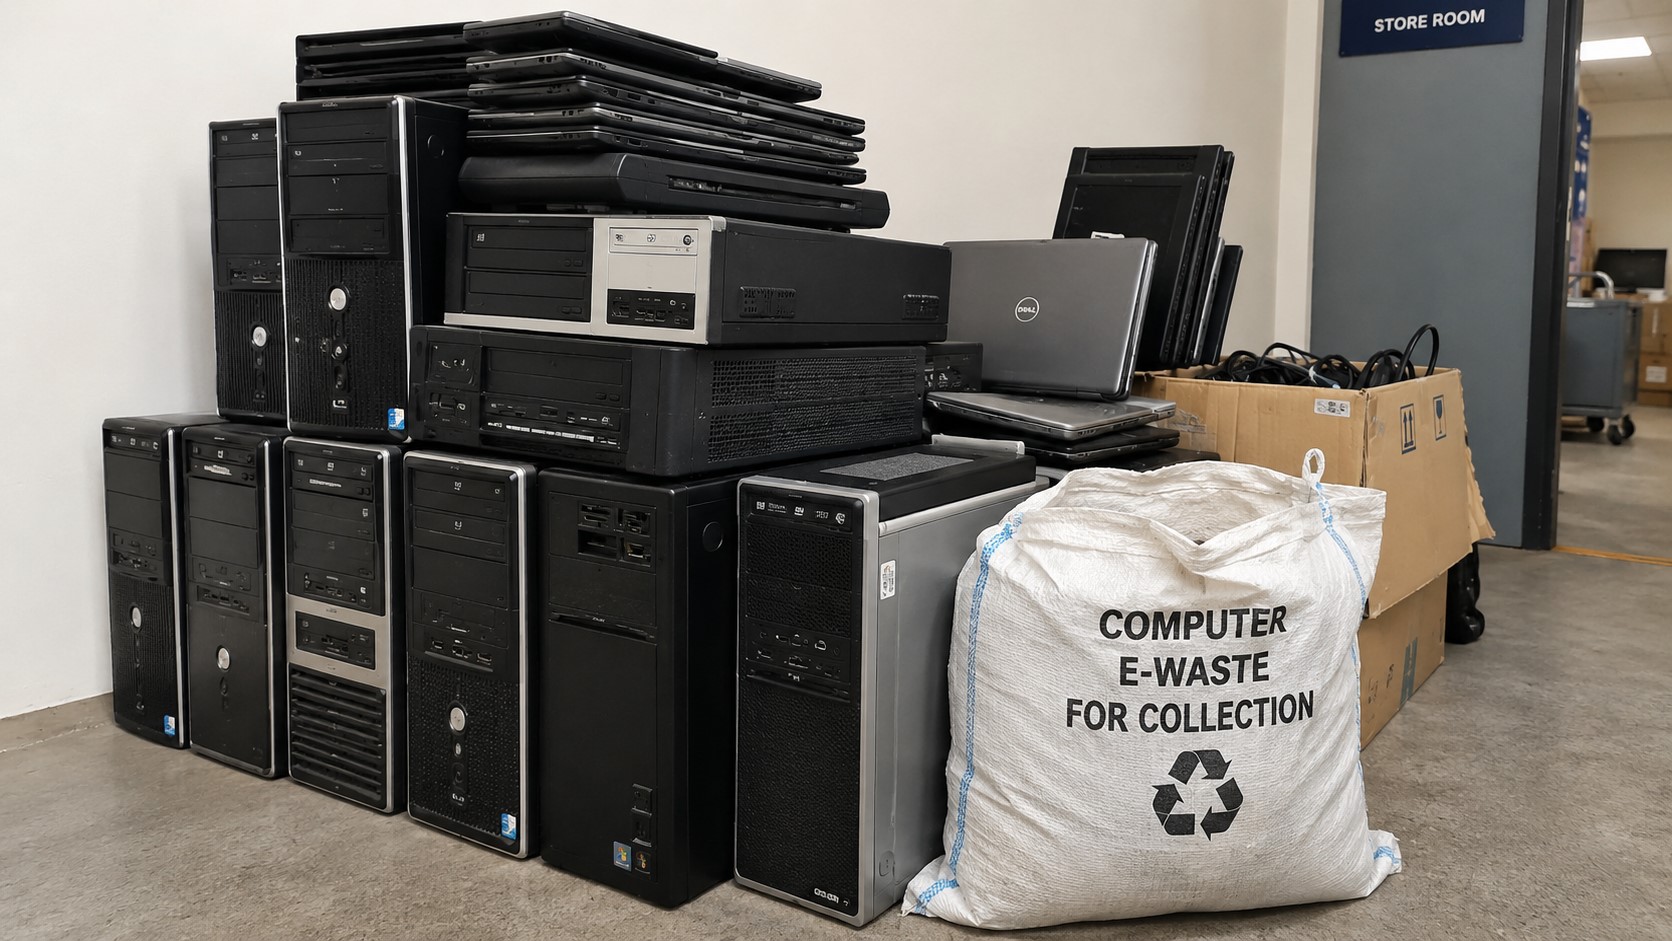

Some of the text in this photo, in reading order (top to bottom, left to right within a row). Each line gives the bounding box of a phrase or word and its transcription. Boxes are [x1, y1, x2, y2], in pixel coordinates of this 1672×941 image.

[1374, 9, 1485, 33] STORE ROOM
[1099, 605, 1287, 641] COMPUTER
[1119, 651, 1270, 687] E-WASTE
[1066, 690, 1314, 734] FOR COLLECTION
